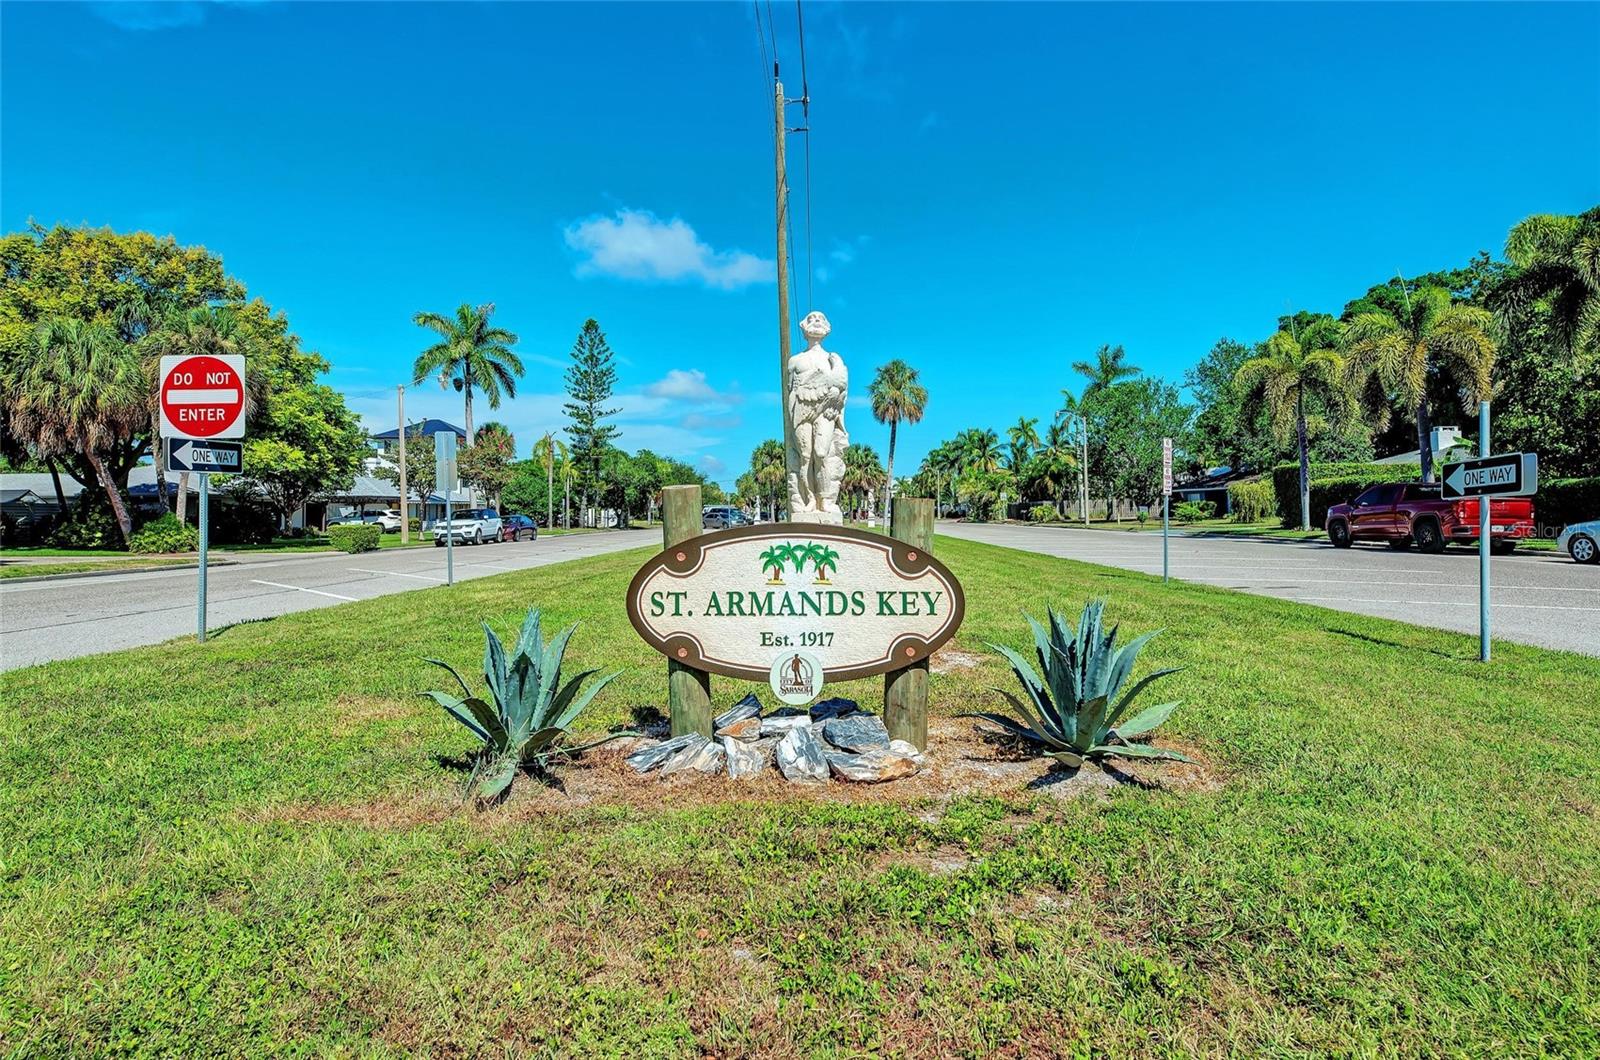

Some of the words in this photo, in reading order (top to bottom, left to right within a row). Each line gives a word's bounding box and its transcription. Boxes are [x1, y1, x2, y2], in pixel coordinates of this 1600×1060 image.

[173, 373, 193, 385] DO
[206, 372, 231, 385] NOT
[179, 408, 225, 422] ENTER
[192, 449, 212, 463] ONE
[215, 450, 235, 464] WAY
[1464, 470, 1485, 486] ONE
[1489, 466, 1513, 483] WAY
[650, 591, 693, 617] ST.
[703, 591, 866, 617] ARMANDS
[876, 591, 943, 617] KEY
[759, 631, 794, 647] Est.
[799, 631, 835, 648] 1917
